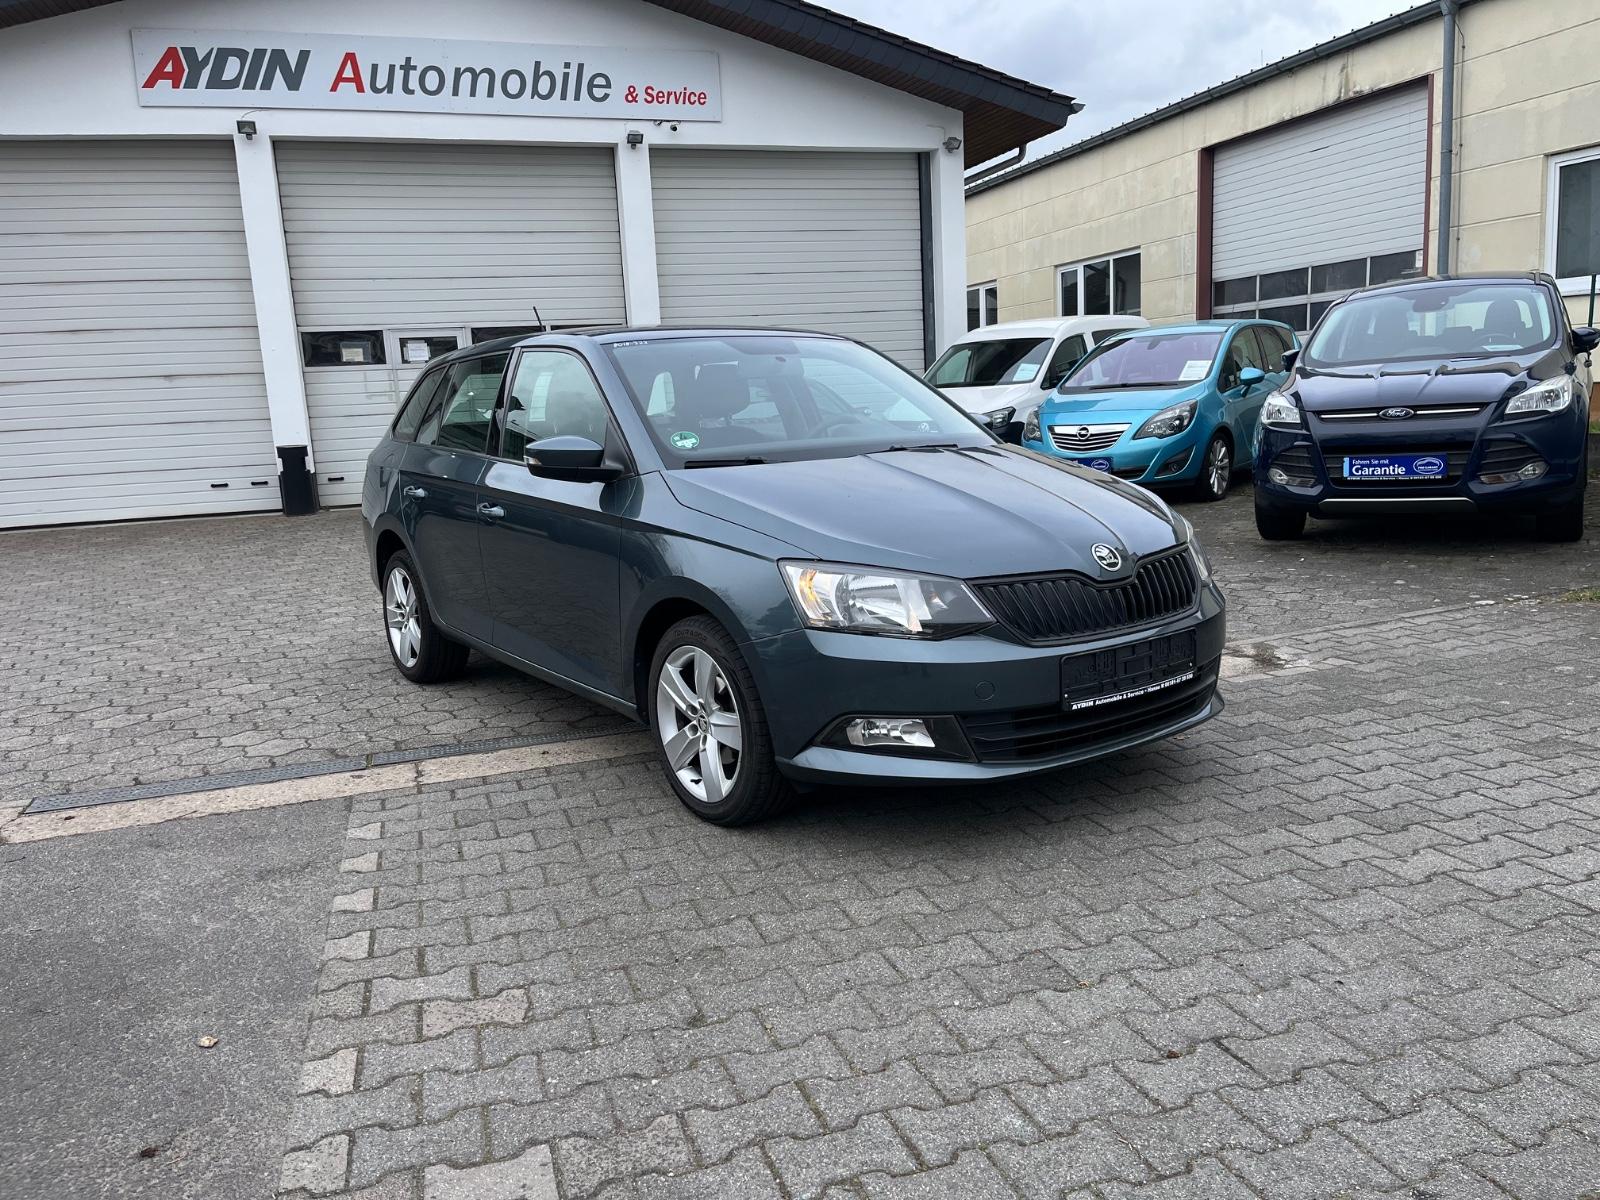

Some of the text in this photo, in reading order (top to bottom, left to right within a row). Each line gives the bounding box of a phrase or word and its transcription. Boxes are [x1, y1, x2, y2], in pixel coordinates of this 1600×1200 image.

[142, 46, 707, 105] AYDIN Automobile & Service
[1352, 464, 1406, 475] Garantie
[1071, 701, 1094, 710] AYDIN
[1095, 695, 1122, 705] Automobile
[1127, 690, 1144, 698] Service
